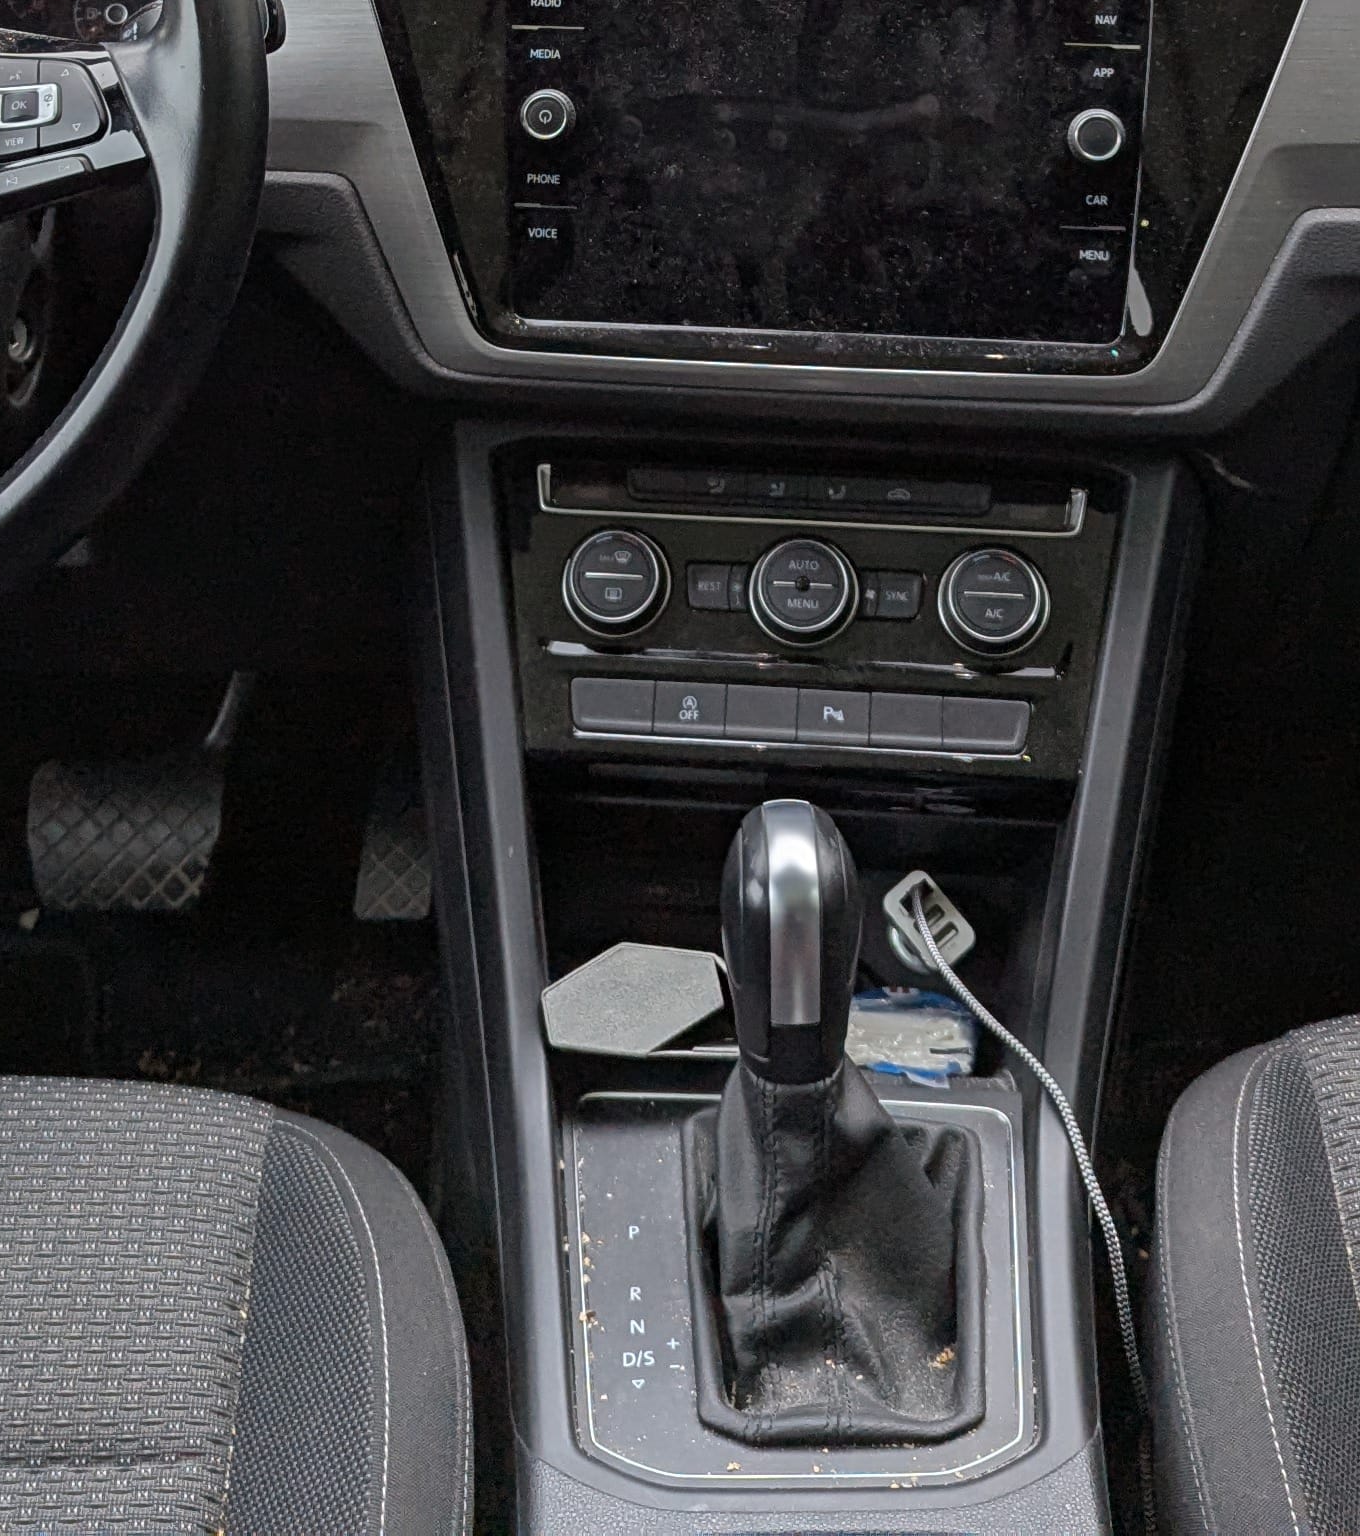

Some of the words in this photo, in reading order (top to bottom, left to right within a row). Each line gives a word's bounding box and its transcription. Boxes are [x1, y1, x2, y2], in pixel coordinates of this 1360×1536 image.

[1095, 15, 1117, 25] NAV
[529, 48, 561, 59] MEDIA
[1093, 67, 1115, 77] APP
[11, 99, 27, 110] OK
[4, 136, 24, 146] VIEW
[527, 173, 561, 184] PHONE
[1086, 195, 1108, 206] CAR
[528, 228, 558, 239] VOICE
[1079, 250, 1110, 261] MENU
[789, 560, 820, 571] AUTO
[993, 571, 1011, 582] A/C
[697, 581, 721, 591] REST
[886, 591, 909, 601] SYNC
[787, 599, 820, 609] MENU
[984, 608, 1005, 619] A/C
[678, 709, 700, 721] OFF
[628, 1225, 640, 1240] P
[630, 1286, 642, 1301] R
[630, 1319, 646, 1334] N
[622, 1350, 656, 1368] D/S
